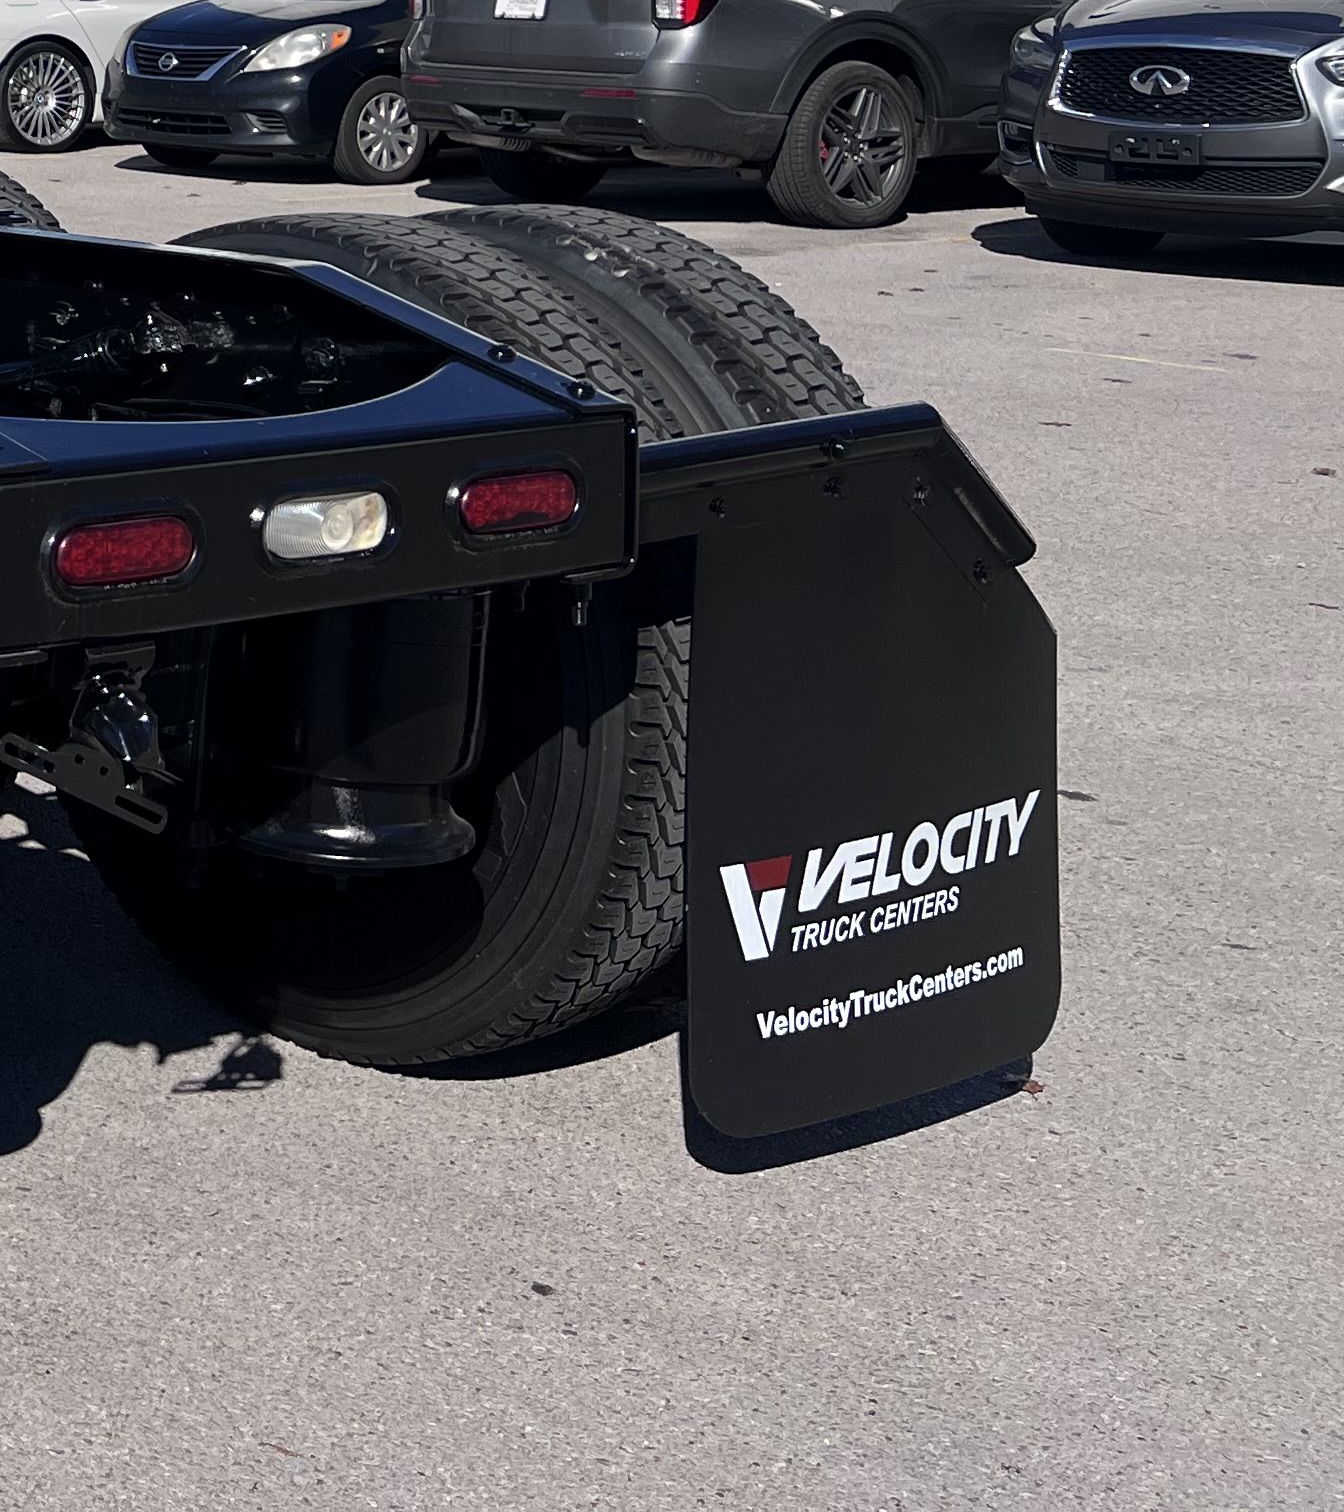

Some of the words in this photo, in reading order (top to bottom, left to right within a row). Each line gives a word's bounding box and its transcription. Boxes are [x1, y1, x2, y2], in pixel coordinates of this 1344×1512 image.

[797, 789, 1042, 912] VELOCITY
[790, 912, 864, 952] TRUCK
[869, 885, 960, 933] CENTERS
[756, 947, 1024, 1039] VelocityTruckCenters.com
